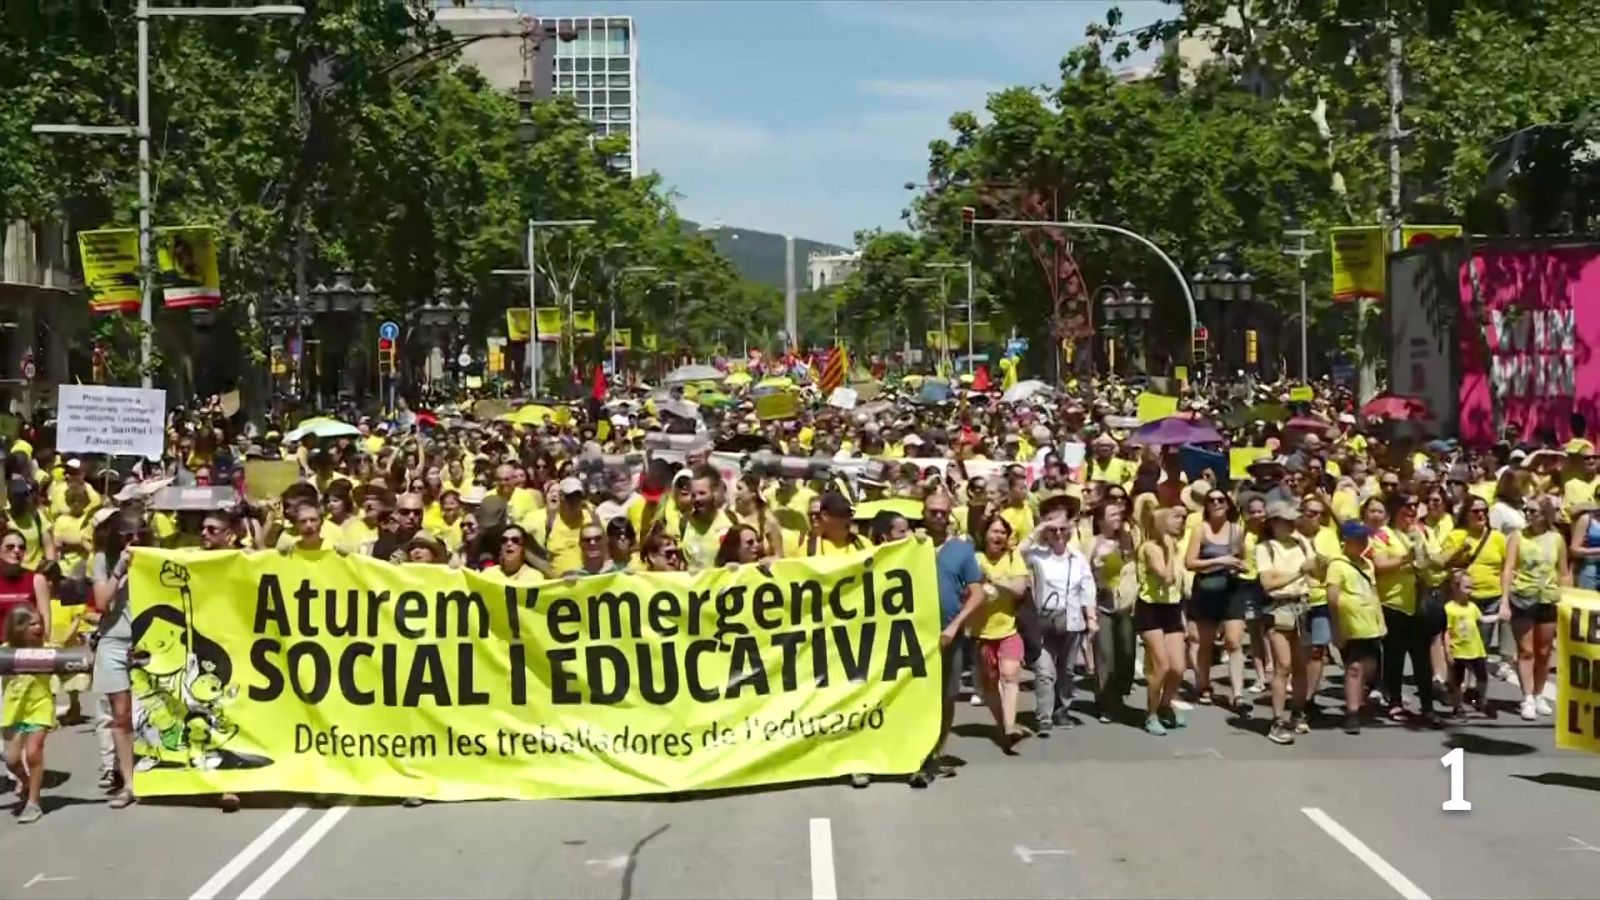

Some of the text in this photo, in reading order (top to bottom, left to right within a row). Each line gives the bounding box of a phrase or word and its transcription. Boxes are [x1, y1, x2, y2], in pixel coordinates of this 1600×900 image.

[253, 557, 915, 652] Aturem l'emergència
[248, 619, 928, 707] SOCIAL I EDUCATIVA
[294, 723, 437, 757] Defensem
[447, 725, 488, 756] les
